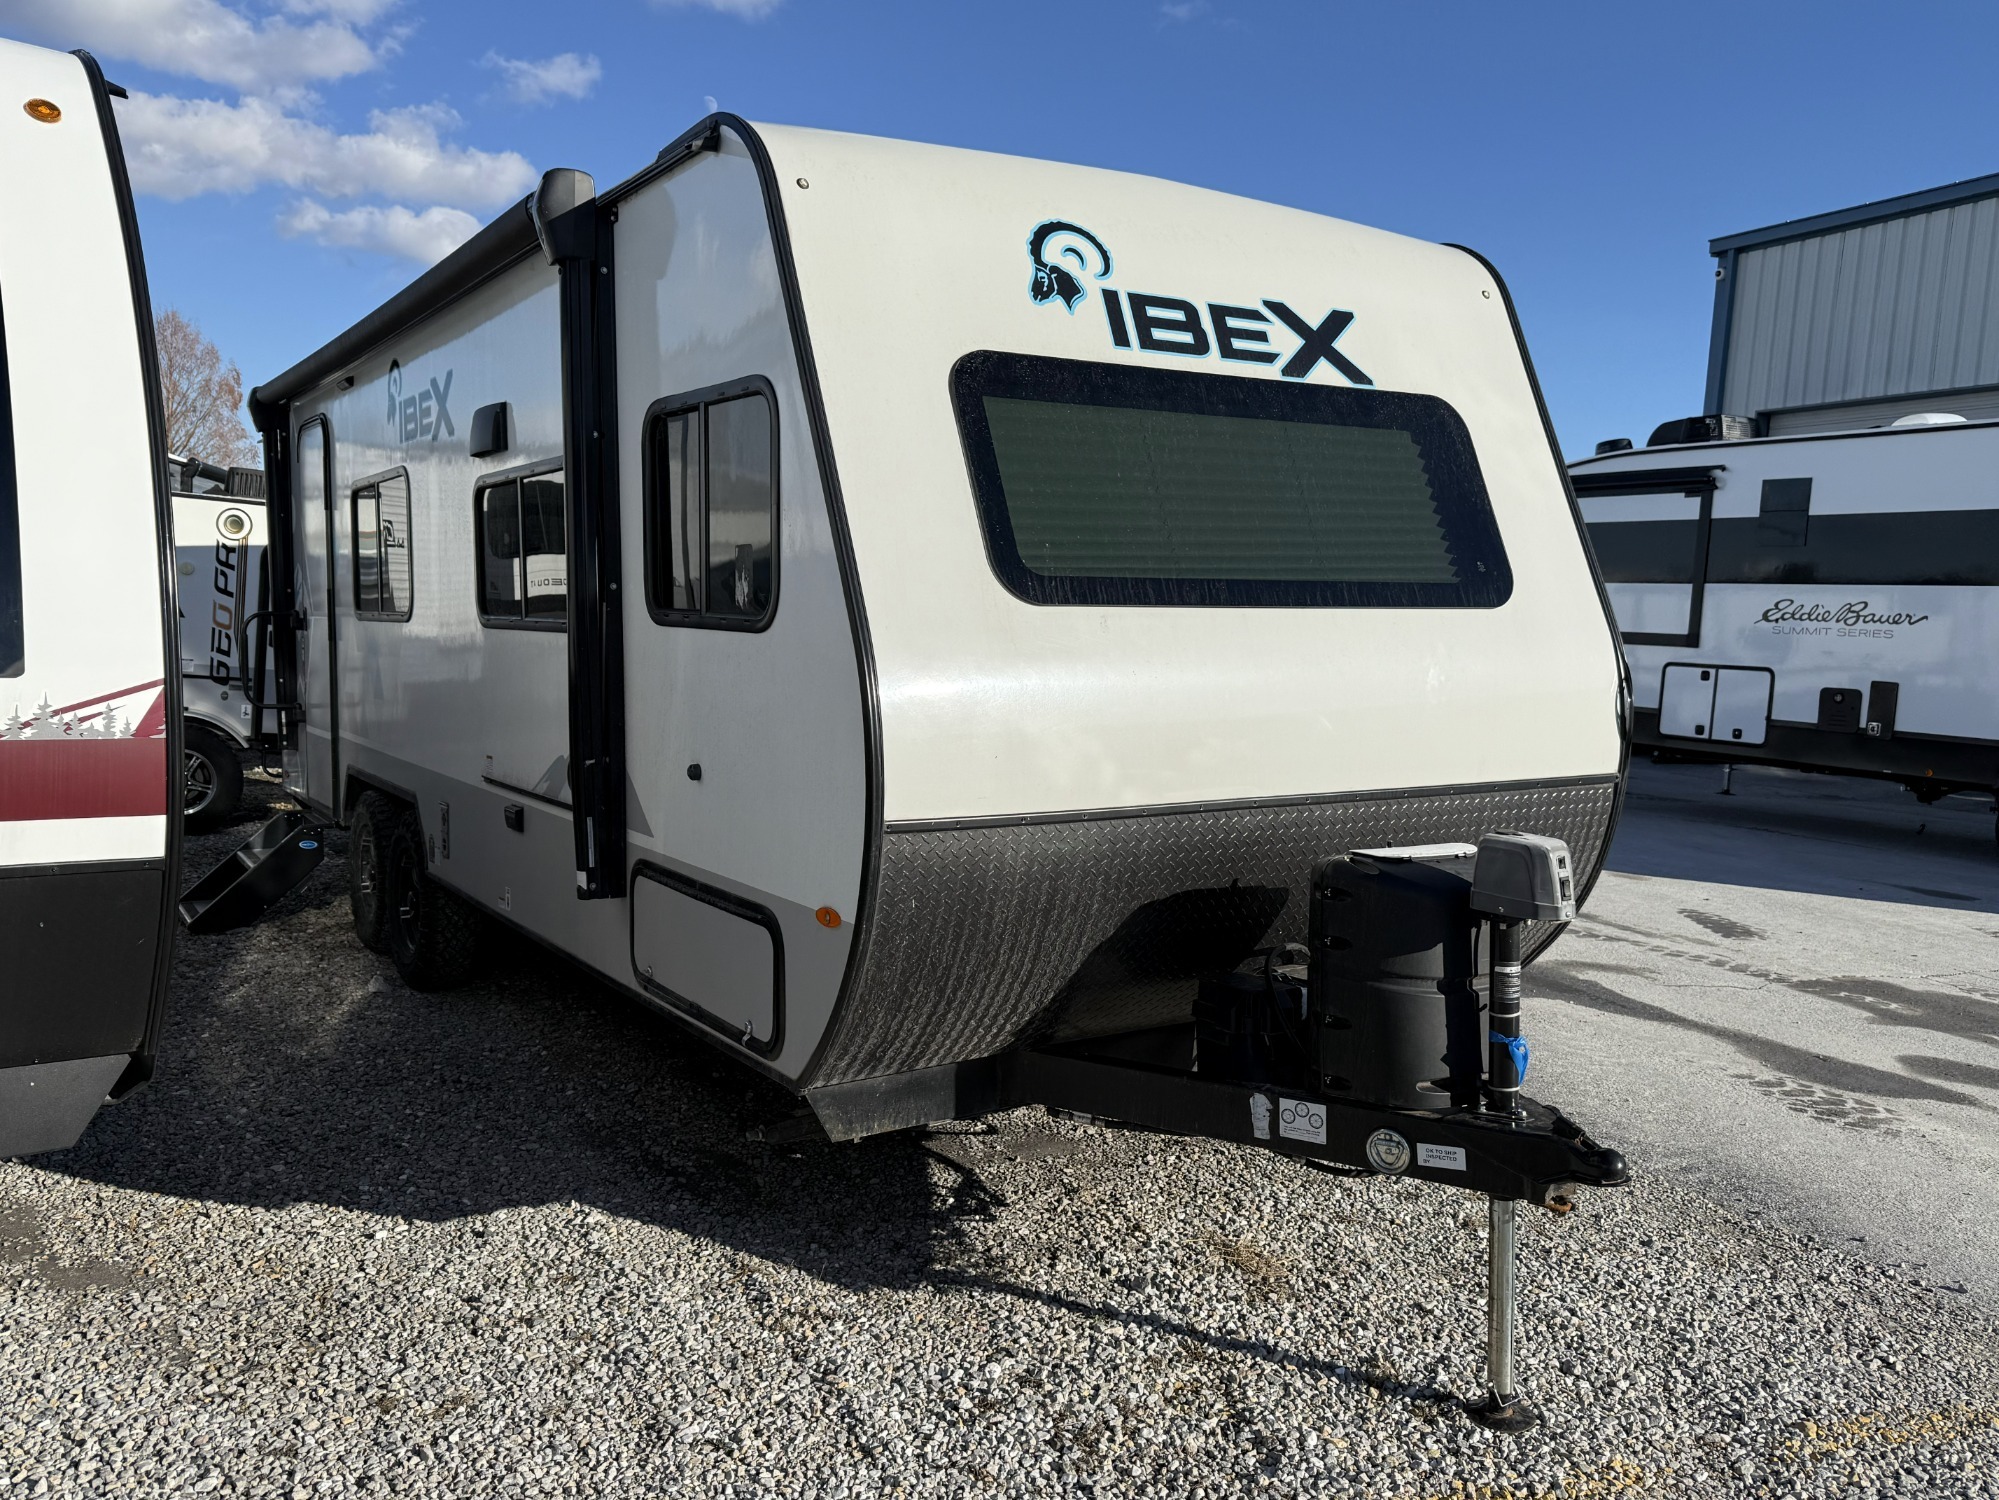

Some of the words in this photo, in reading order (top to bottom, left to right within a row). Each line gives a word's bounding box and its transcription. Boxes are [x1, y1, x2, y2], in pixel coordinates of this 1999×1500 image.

[1099, 287, 1376, 388] IBEX
[399, 368, 455, 444] IBEX
[210, 599, 234, 686] GEO
[1754, 599, 1833, 624] Eddie
[1834, 601, 1928, 626] Bauer
[1771, 625, 1832, 636] SUMMIT
[1836, 627, 1894, 639] SERIES
